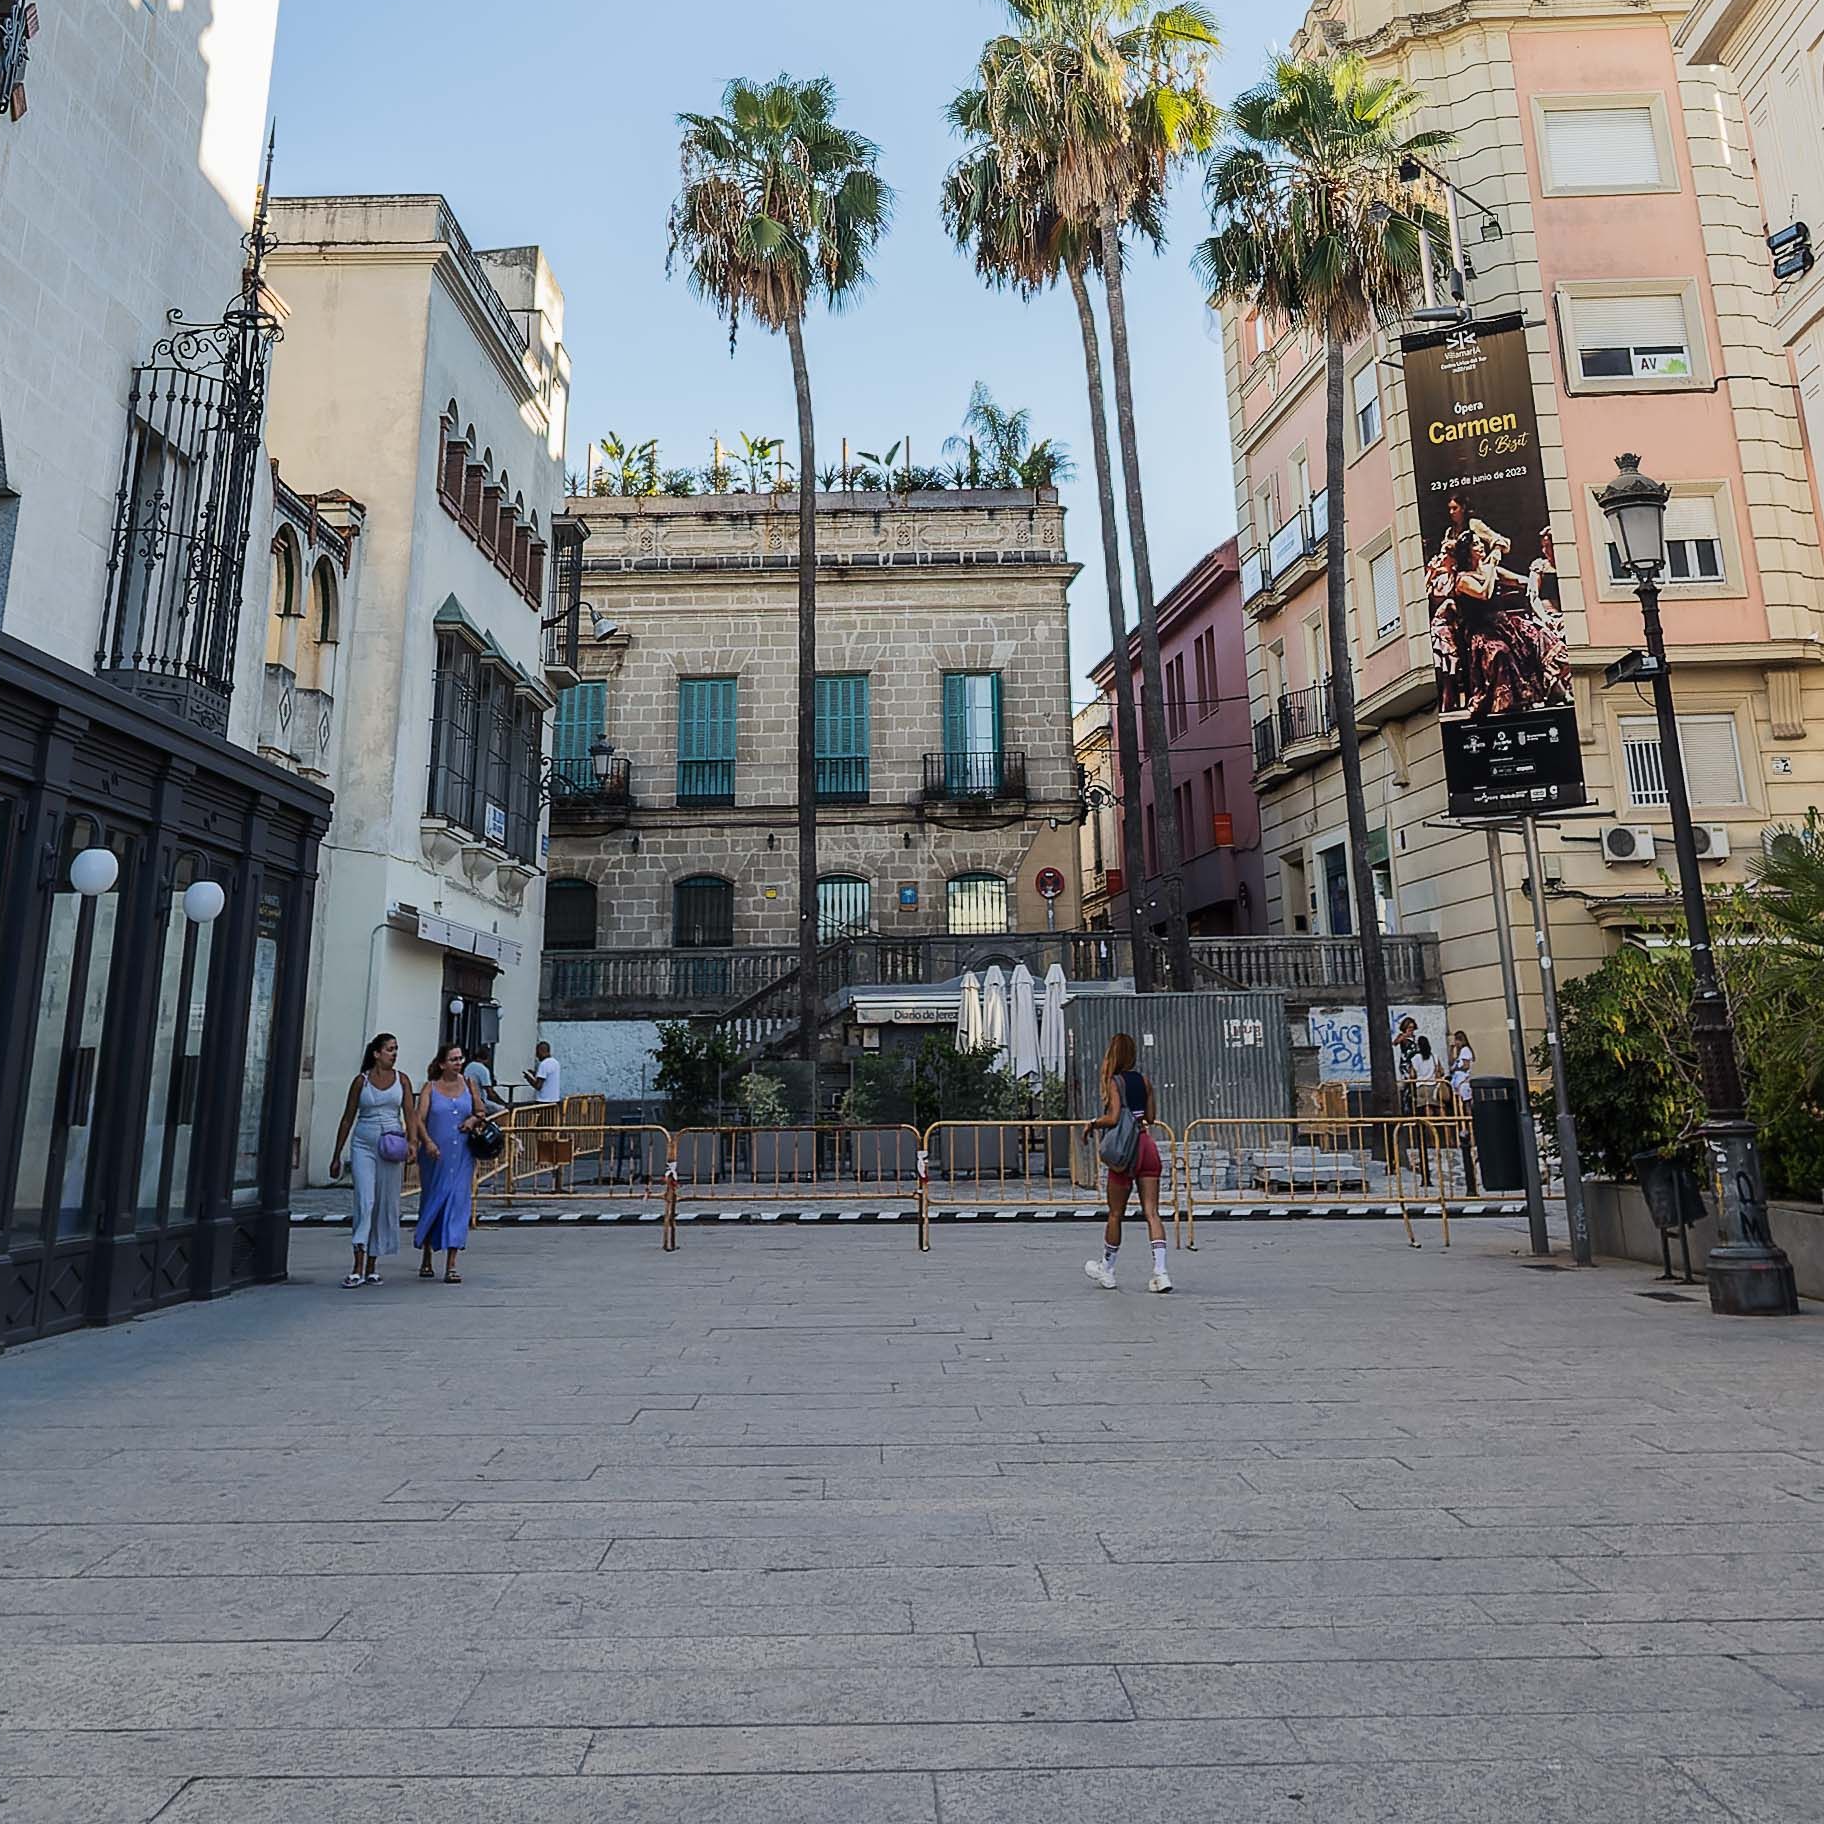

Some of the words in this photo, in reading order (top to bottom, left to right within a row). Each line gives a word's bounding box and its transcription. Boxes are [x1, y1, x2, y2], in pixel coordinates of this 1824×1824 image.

[1453, 401, 1484, 415] Ópera
[1428, 412, 1517, 444] Carmen
[1478, 438, 1492, 458] G.
[1430, 481, 1442, 491] 23
[1442, 481, 1448, 491] y
[1449, 477, 1460, 488] 25
[1460, 476, 1471, 485] de
[1472, 472, 1493, 485] junio
[1493, 471, 1504, 480] de
[1505, 466, 1527, 478] 2023
[894, 1010, 922, 1020] Diario
[922, 1010, 935, 1020] de
